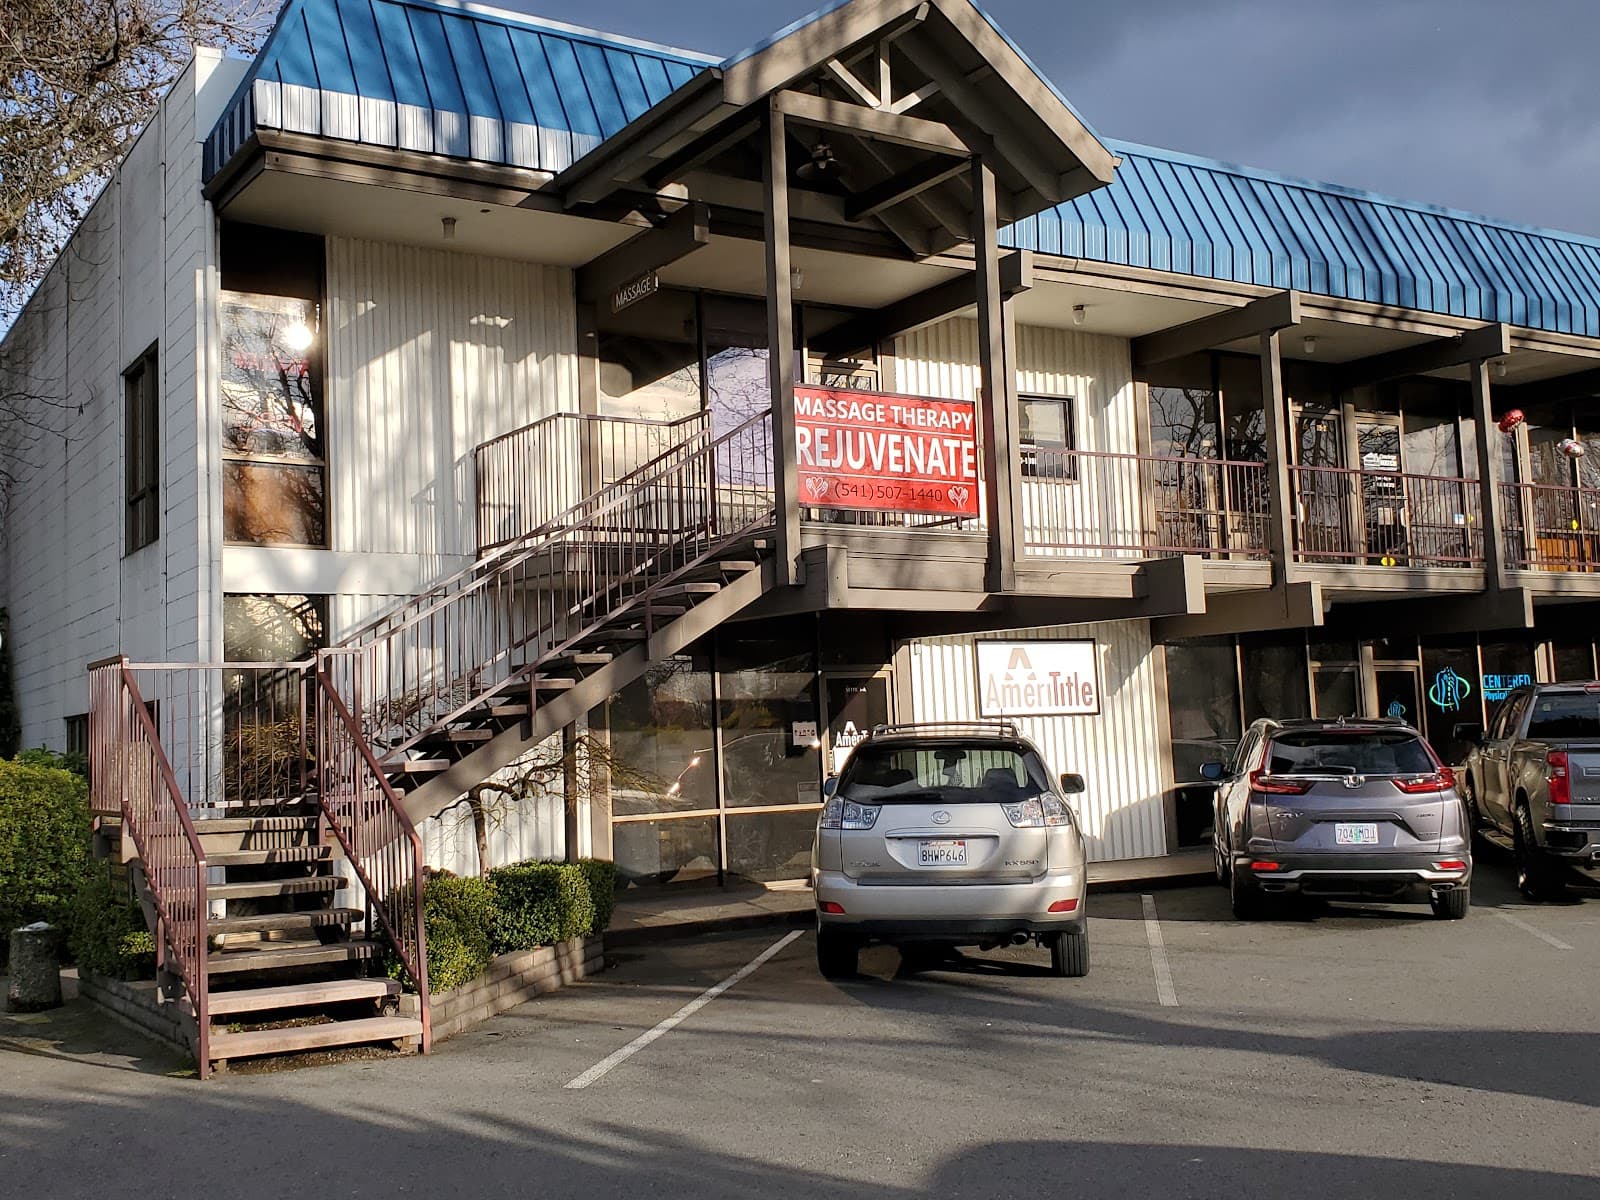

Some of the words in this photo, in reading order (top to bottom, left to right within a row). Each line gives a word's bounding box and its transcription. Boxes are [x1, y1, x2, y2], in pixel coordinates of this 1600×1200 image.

[615, 275, 652, 309] MASSAGE
[794, 396, 886, 423] MASSAGE
[890, 405, 973, 431] THERAPY
[795, 426, 976, 478] REJUVENATE
[986, 671, 1093, 709] AmeriTitle
[1483, 674, 1531, 689] CENTERED
[921, 849, 965, 862] 8HWP646
